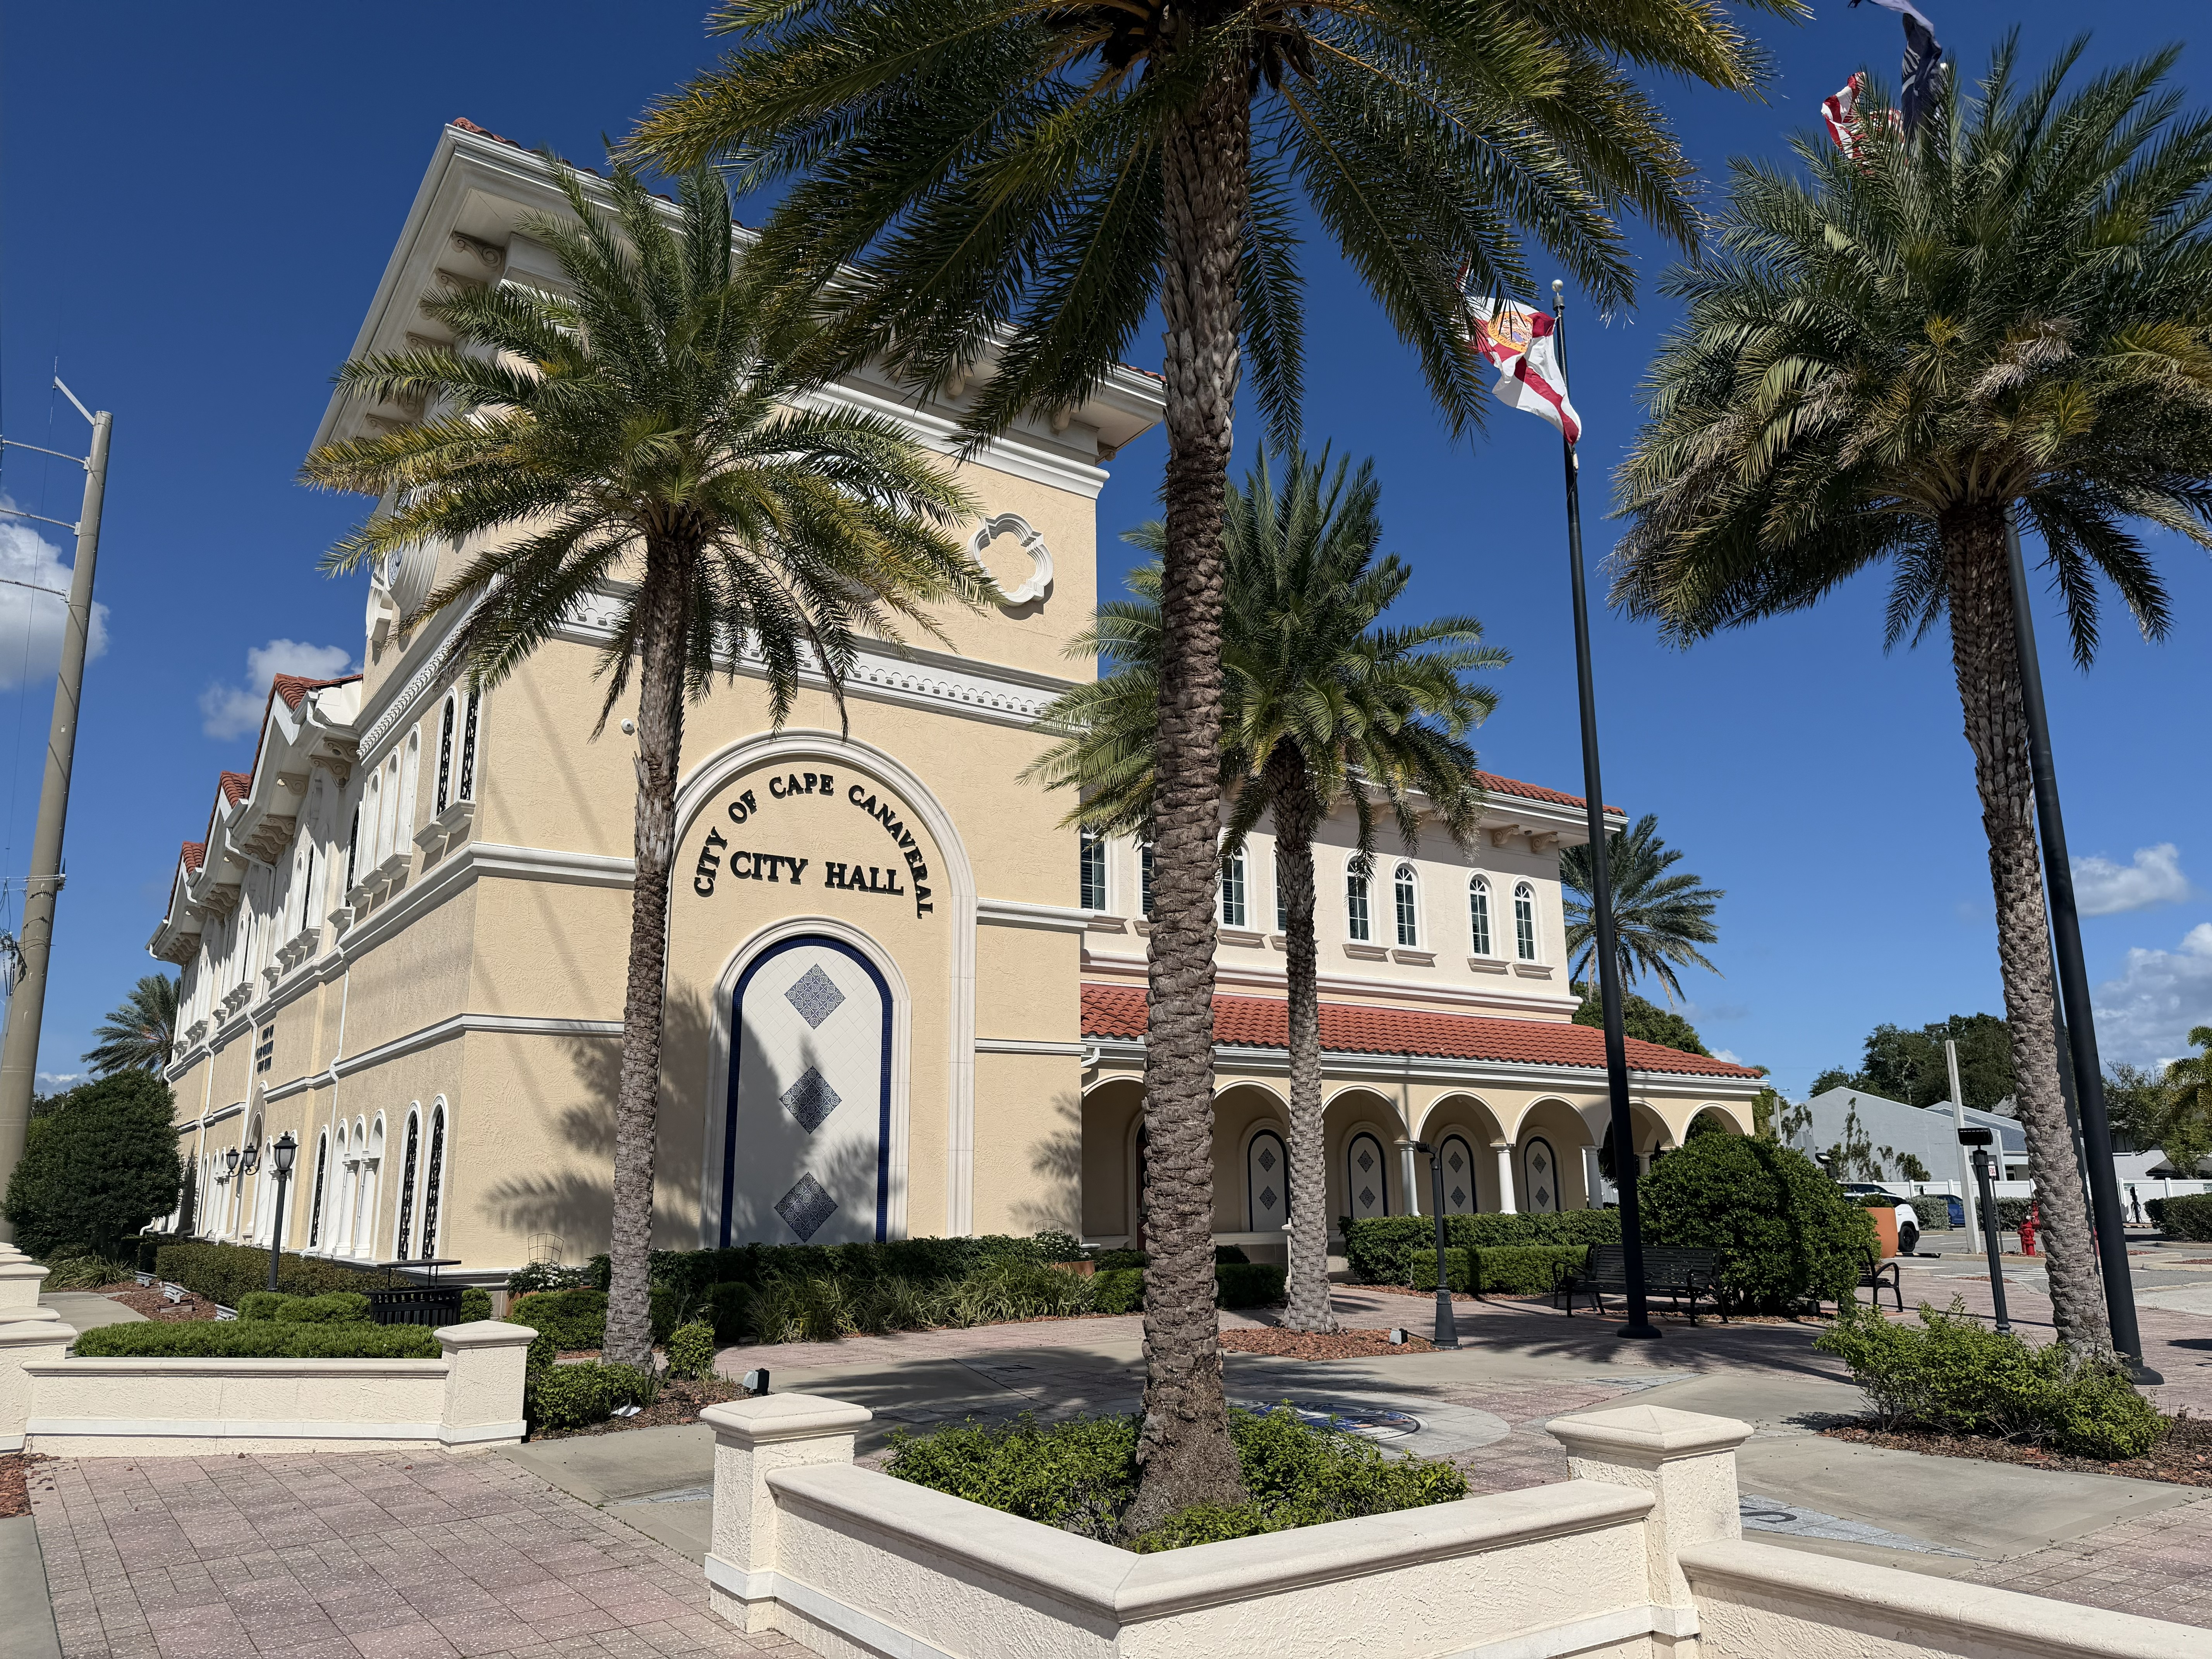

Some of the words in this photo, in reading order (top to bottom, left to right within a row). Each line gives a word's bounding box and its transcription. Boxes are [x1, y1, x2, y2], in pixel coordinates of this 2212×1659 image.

[694, 826, 728, 897] CITY
[728, 789, 757, 824] OF
[769, 773, 834, 799] CAPE
[848, 785, 933, 919] CANAVERAL
[730, 851, 808, 885] CITY
[825, 862, 904, 896] HALL
